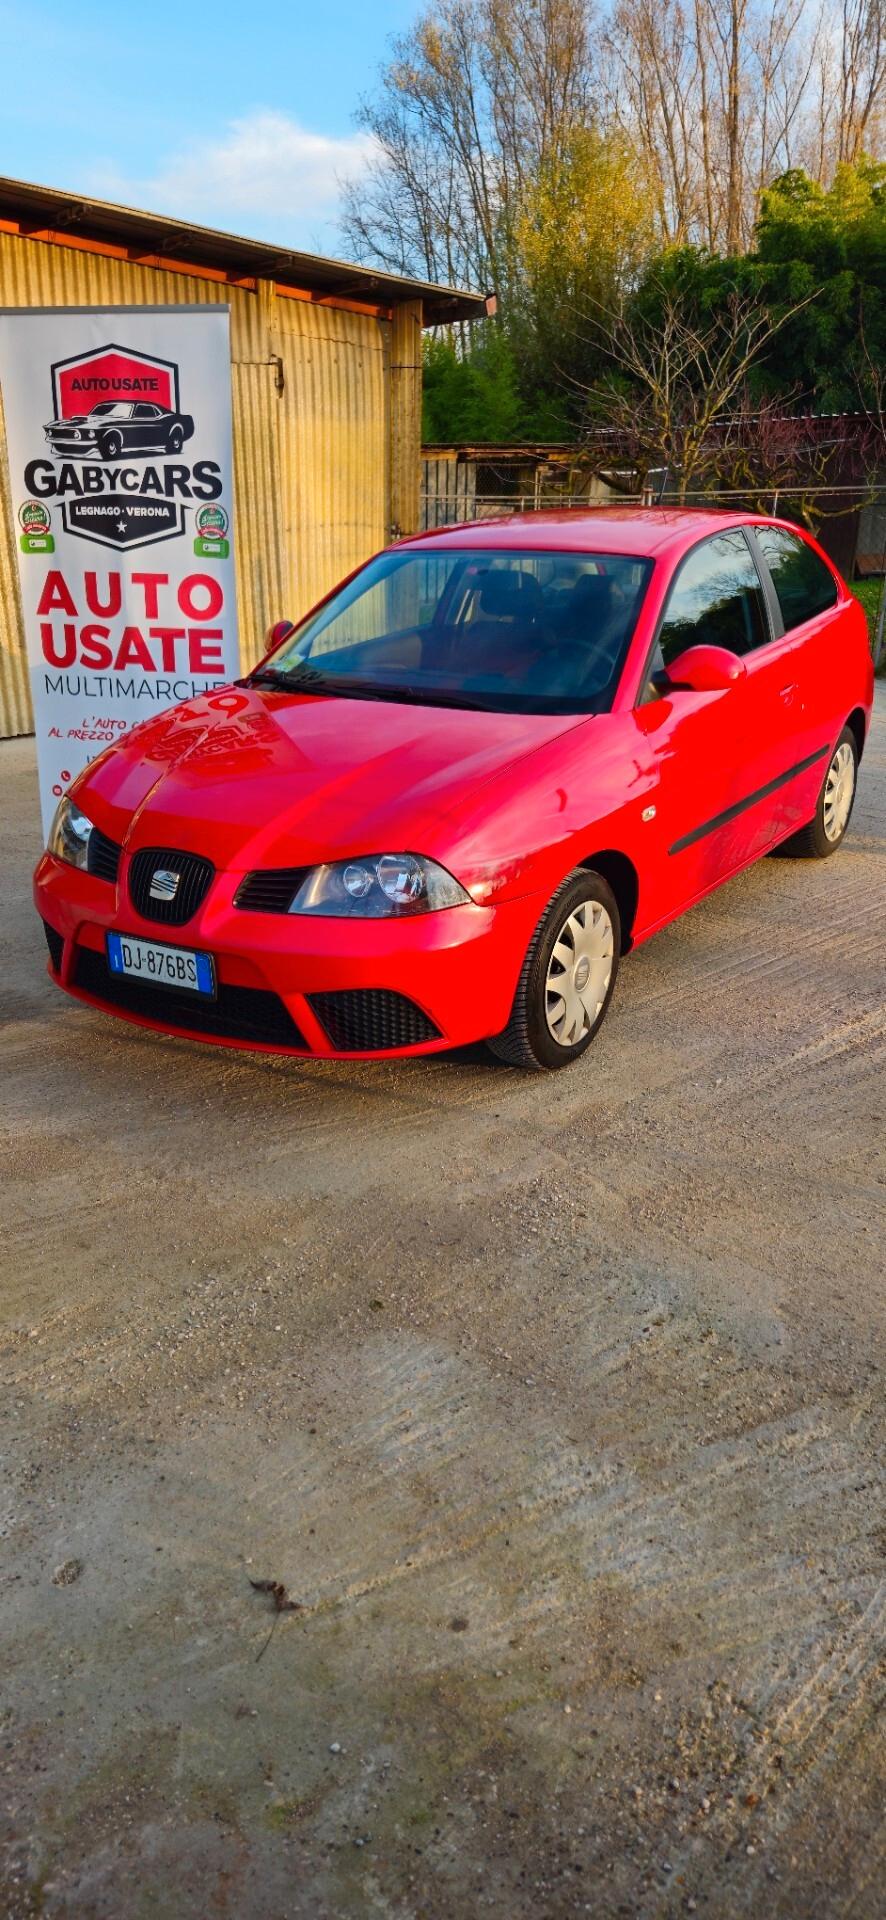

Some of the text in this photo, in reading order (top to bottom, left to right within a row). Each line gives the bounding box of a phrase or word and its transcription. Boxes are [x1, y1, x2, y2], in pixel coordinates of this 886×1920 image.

[71, 378, 159, 391] AUTO USATE
[24, 459, 223, 500] GABYCARS
[75, 505, 120, 516] LEGNAGO
[126, 506, 170, 517] VERONA
[36, 570, 224, 621] AUTO
[40, 623, 225, 674] USATE
[82, 716, 126, 729] L'AUTO
[48, 727, 63, 738] AL
[67, 729, 114, 741] PREZZO
